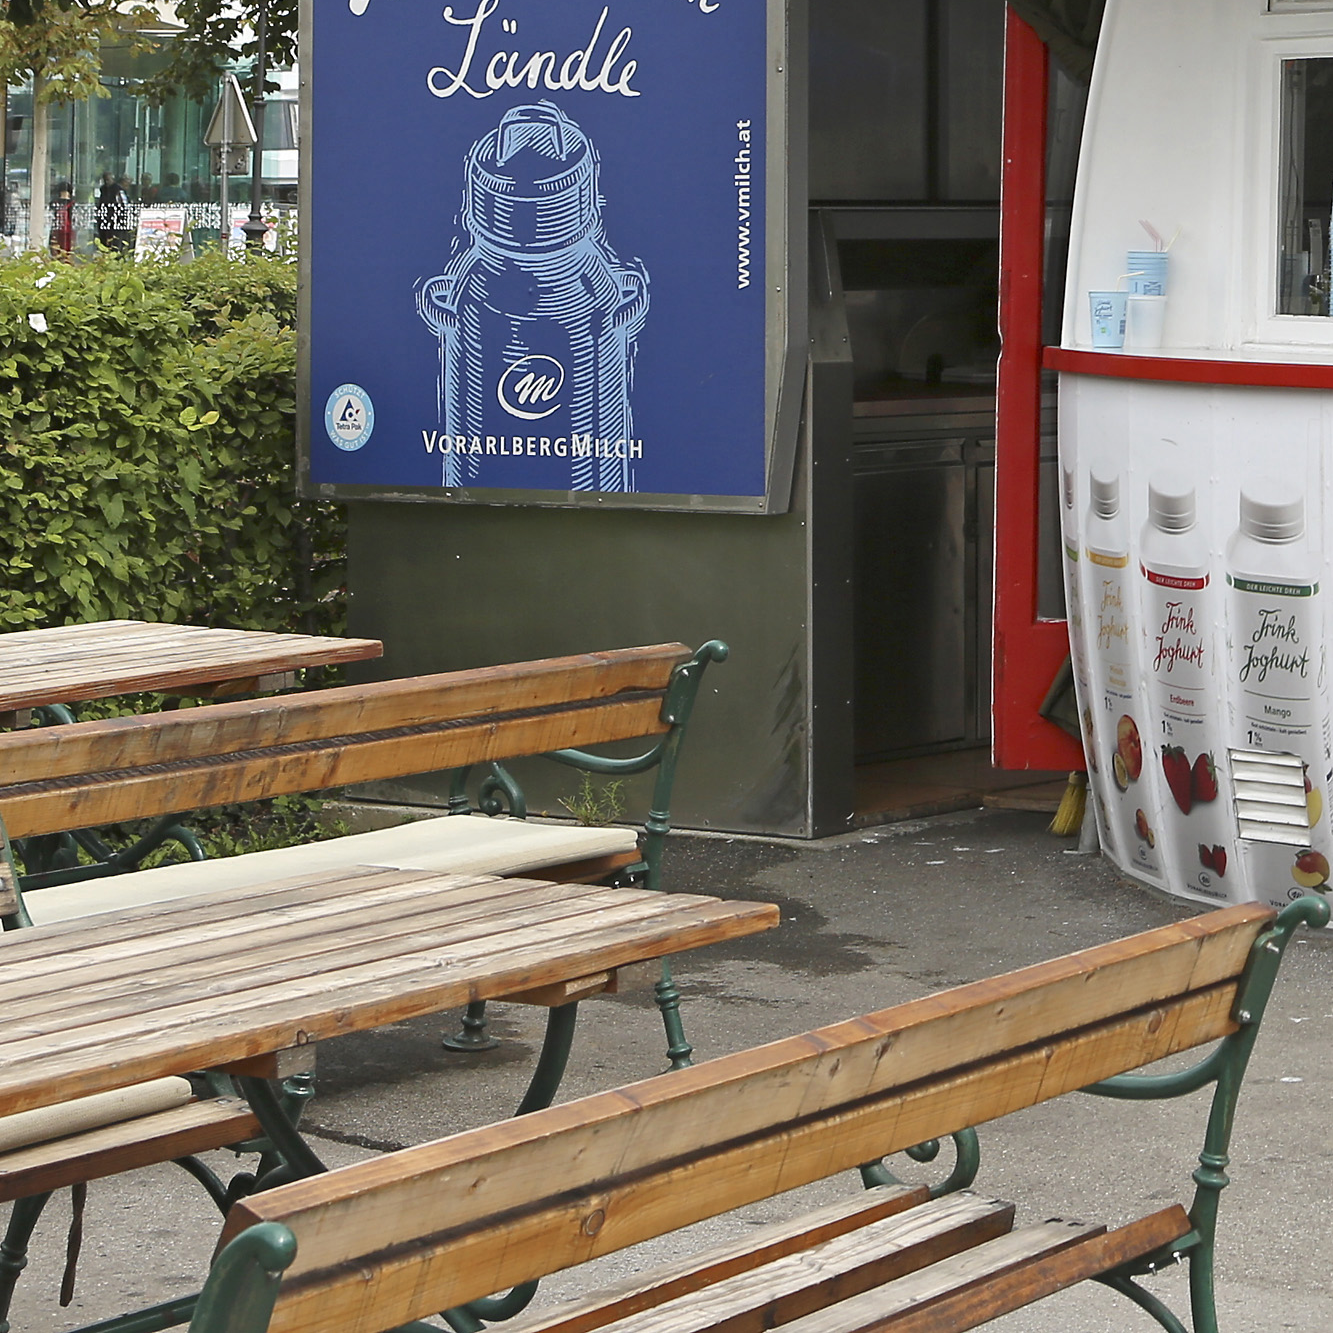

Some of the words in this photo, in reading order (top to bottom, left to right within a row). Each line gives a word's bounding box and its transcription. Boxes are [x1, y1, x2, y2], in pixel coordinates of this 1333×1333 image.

[734, 119, 751, 289] www.vmilch.at
[1162, 601, 1196, 635] Trink
[1252, 609, 1300, 644] Trink
[1153, 635, 1205, 672] Joghurt
[1239, 645, 1309, 682] Joghurt
[1264, 705, 1291, 718] Mango
